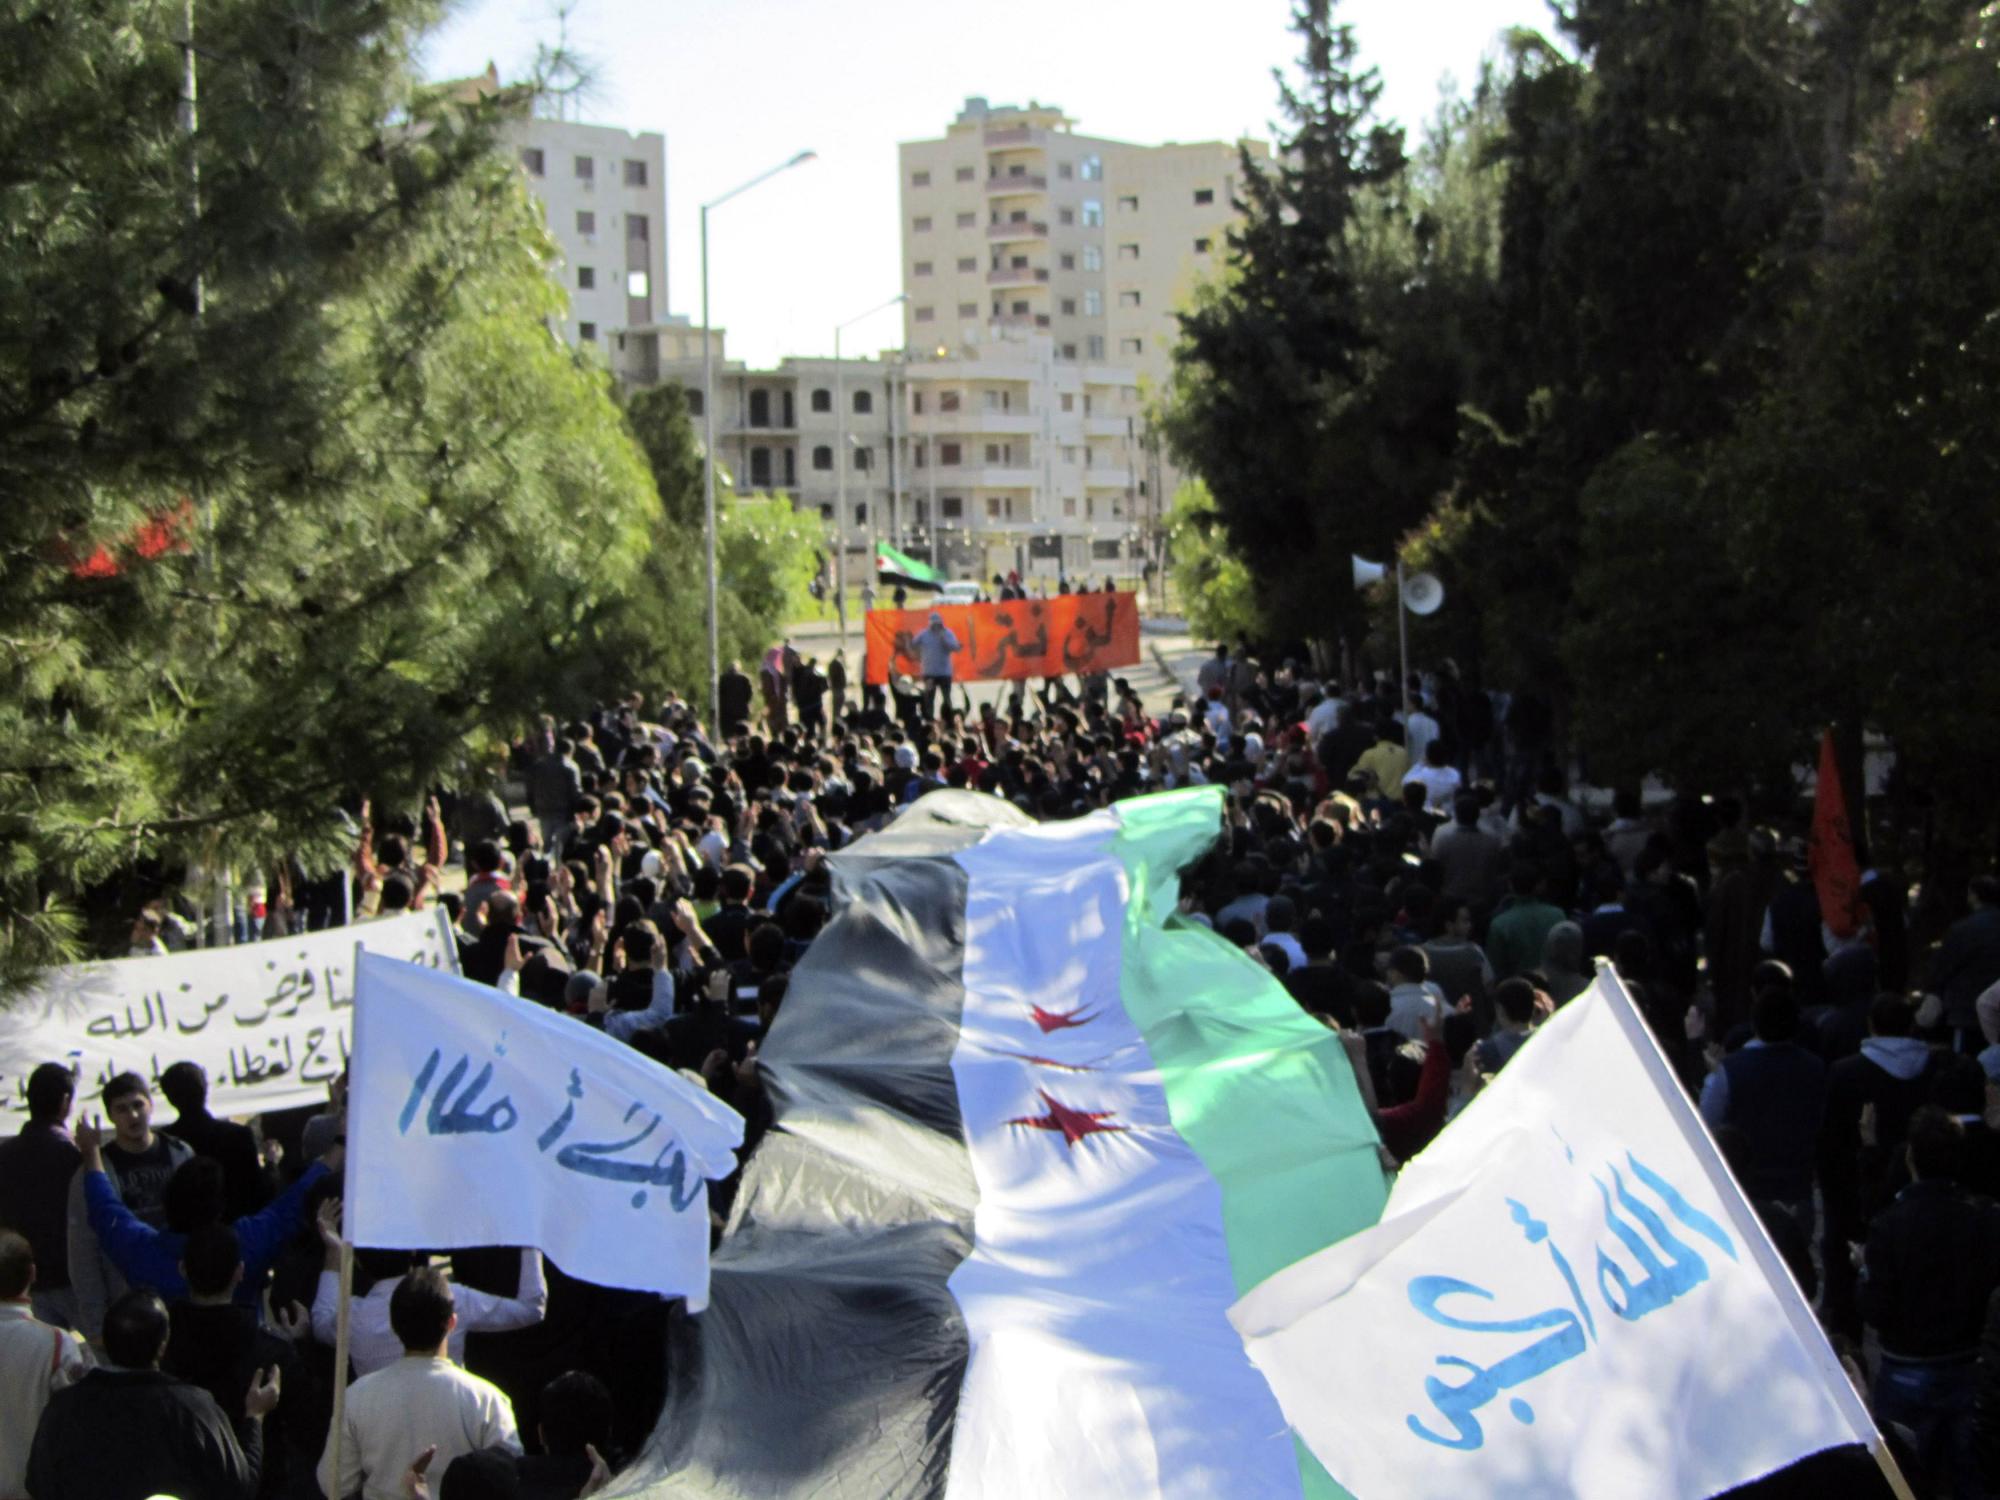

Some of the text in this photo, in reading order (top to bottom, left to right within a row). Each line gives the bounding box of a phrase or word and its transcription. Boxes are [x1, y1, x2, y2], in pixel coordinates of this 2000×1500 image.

[1063, 597, 1117, 670] لن
[86, 990, 169, 1040] الله
[175, 981, 230, 1034] من
[234, 951, 316, 1026] فرض
[1405, 1122, 1740, 1450] الله أكبر
